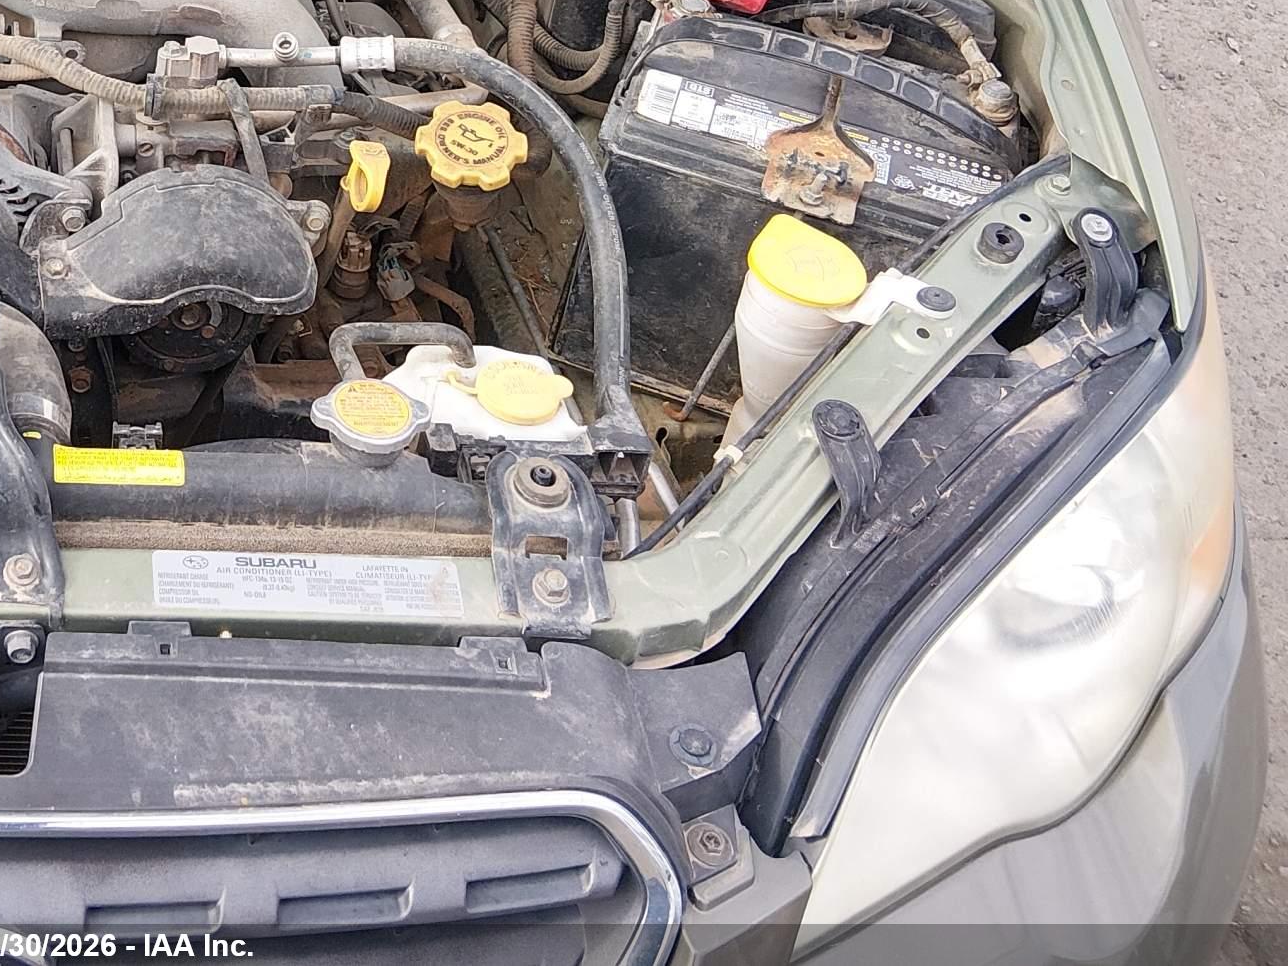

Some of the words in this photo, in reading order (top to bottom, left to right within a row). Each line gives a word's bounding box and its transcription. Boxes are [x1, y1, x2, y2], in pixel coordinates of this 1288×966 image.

[457, 112, 497, 127] ENGINE
[495, 123, 508, 139] OIL
[439, 118, 455, 132] SEE
[473, 145, 506, 165] MANUAL
[234, 568, 292, 576] CONDITIONER
[235, 557, 317, 569] SUBARU
